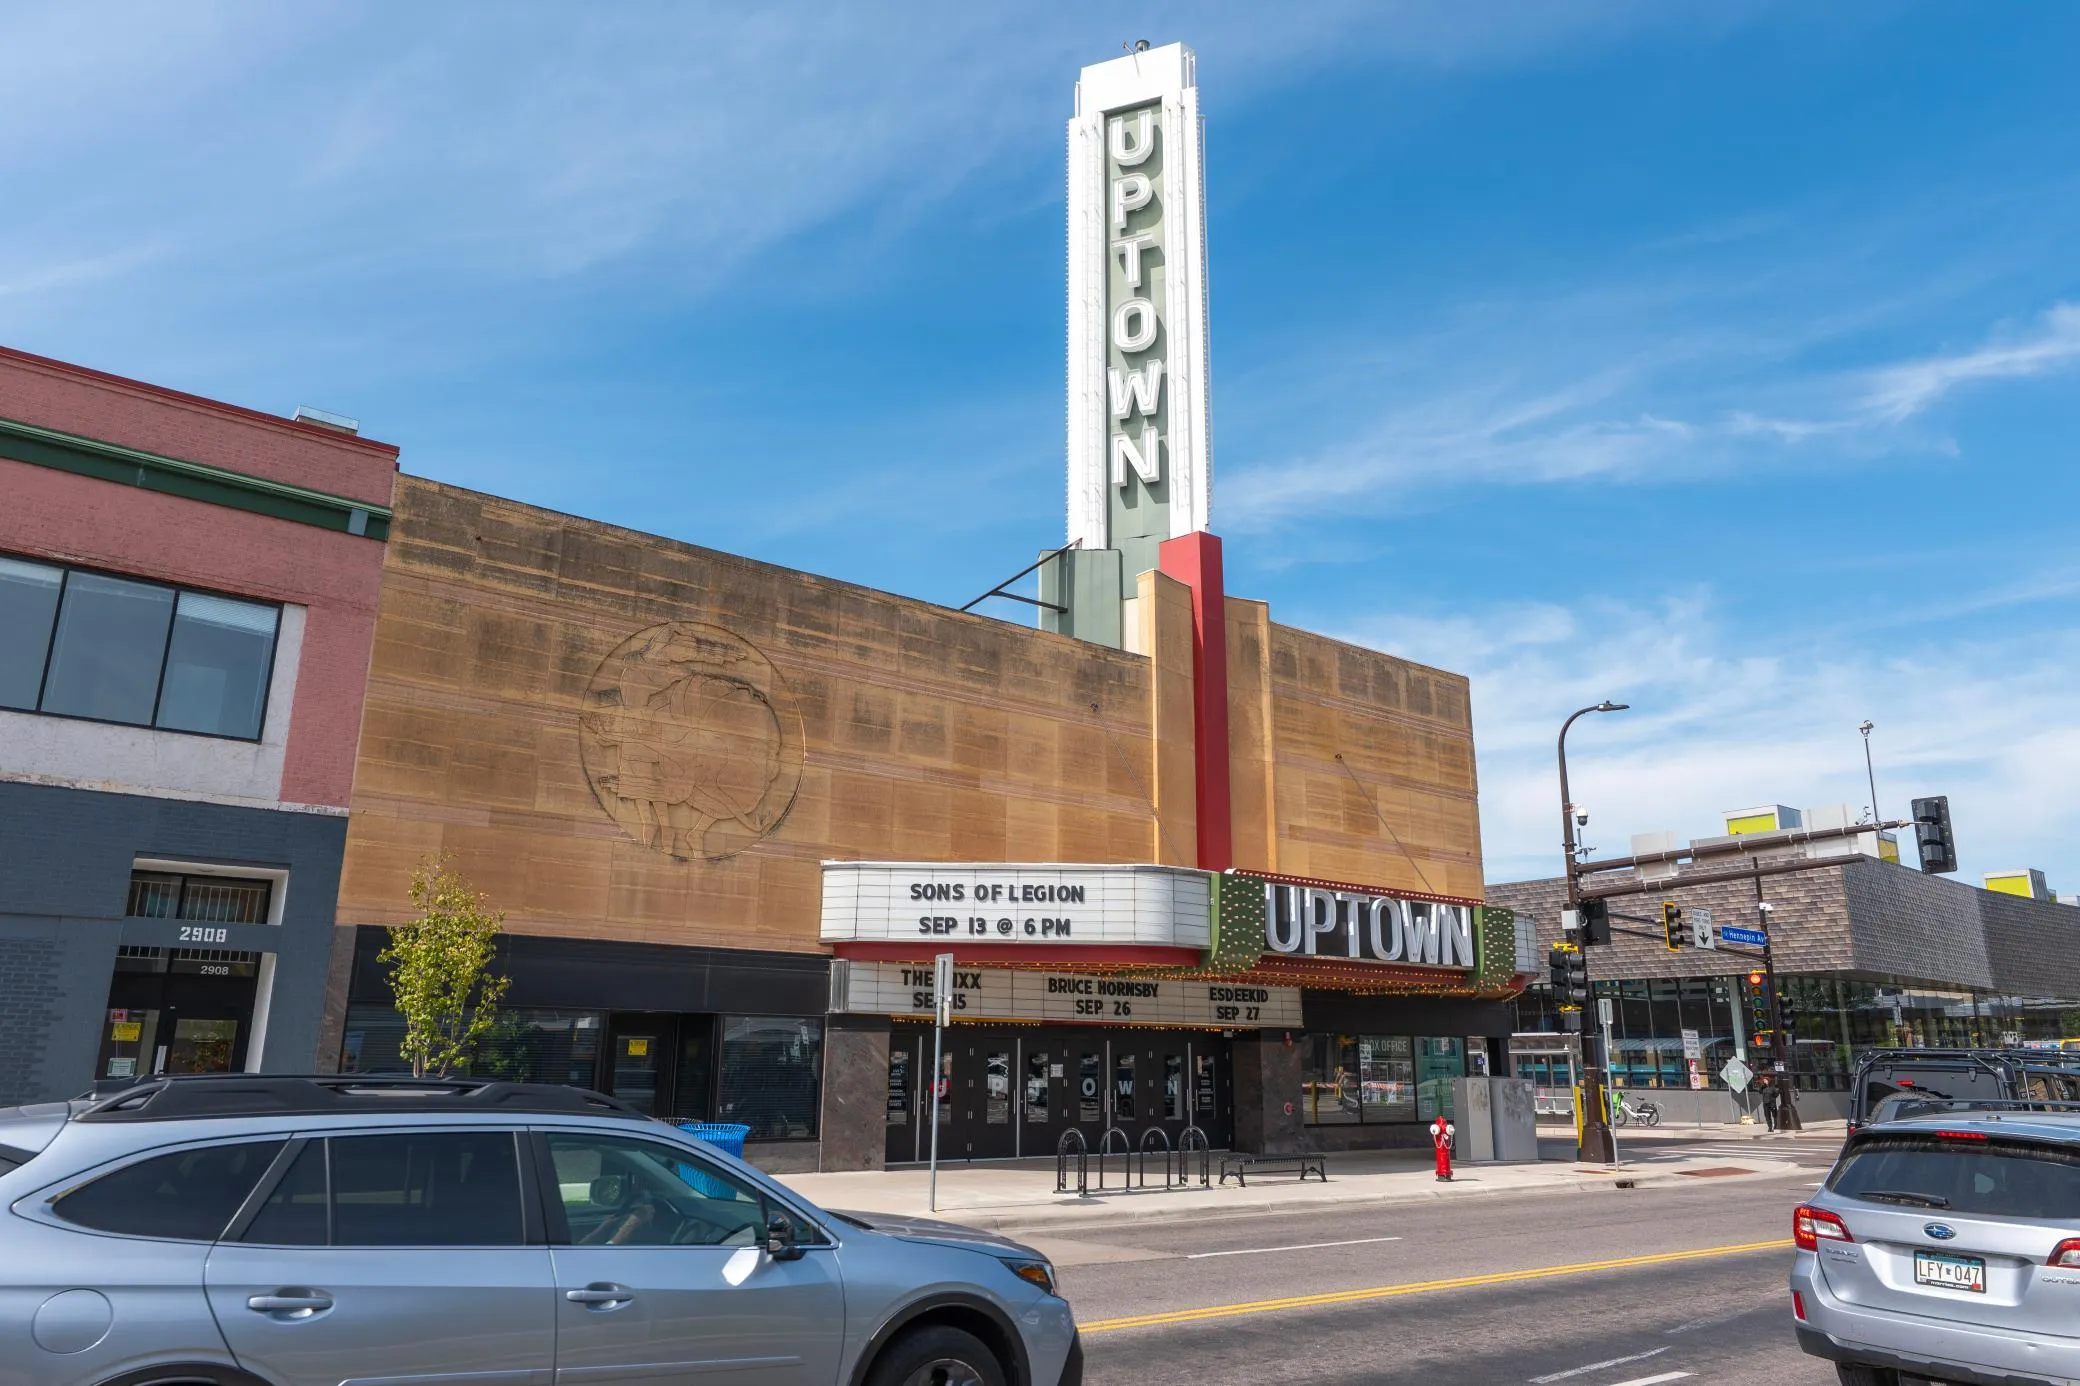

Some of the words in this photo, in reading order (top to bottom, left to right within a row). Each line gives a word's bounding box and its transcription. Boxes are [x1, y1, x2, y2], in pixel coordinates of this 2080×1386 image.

[1107, 109, 1162, 487] UPTOWN
[910, 883, 964, 901] SONS
[974, 884, 1003, 901] OF
[1008, 884, 1085, 903] LEGION
[918, 916, 958, 935] SEP
[968, 917, 986, 935] 13
[996, 918, 1013, 935] @
[1024, 918, 1036, 936] 6
[1041, 918, 1072, 936] PM
[1264, 882, 1474, 967] UPTOWN
[179, 926, 227, 943] 2908
[1729, 929, 1756, 943] Hennepin
[200, 965, 229, 975] 2908
[901, 970, 934, 988] THE
[1048, 978, 1093, 995] BRUCE
[1097, 979, 1159, 998] HORNSBY
[1209, 987, 1269, 1003] ESDEEKID
[913, 992, 938, 1010] SE
[953, 994, 967, 1011] 15
[1076, 999, 1103, 1016] SEP
[1113, 1001, 1131, 1016] 26
[1216, 1006, 1240, 1021] SEP
[1246, 1007, 1260, 1021] 27
[1381, 1040, 1408, 1052] OFFICE
[1919, 1260, 1943, 1279] LFY
[1954, 1265, 1980, 1284] 047
